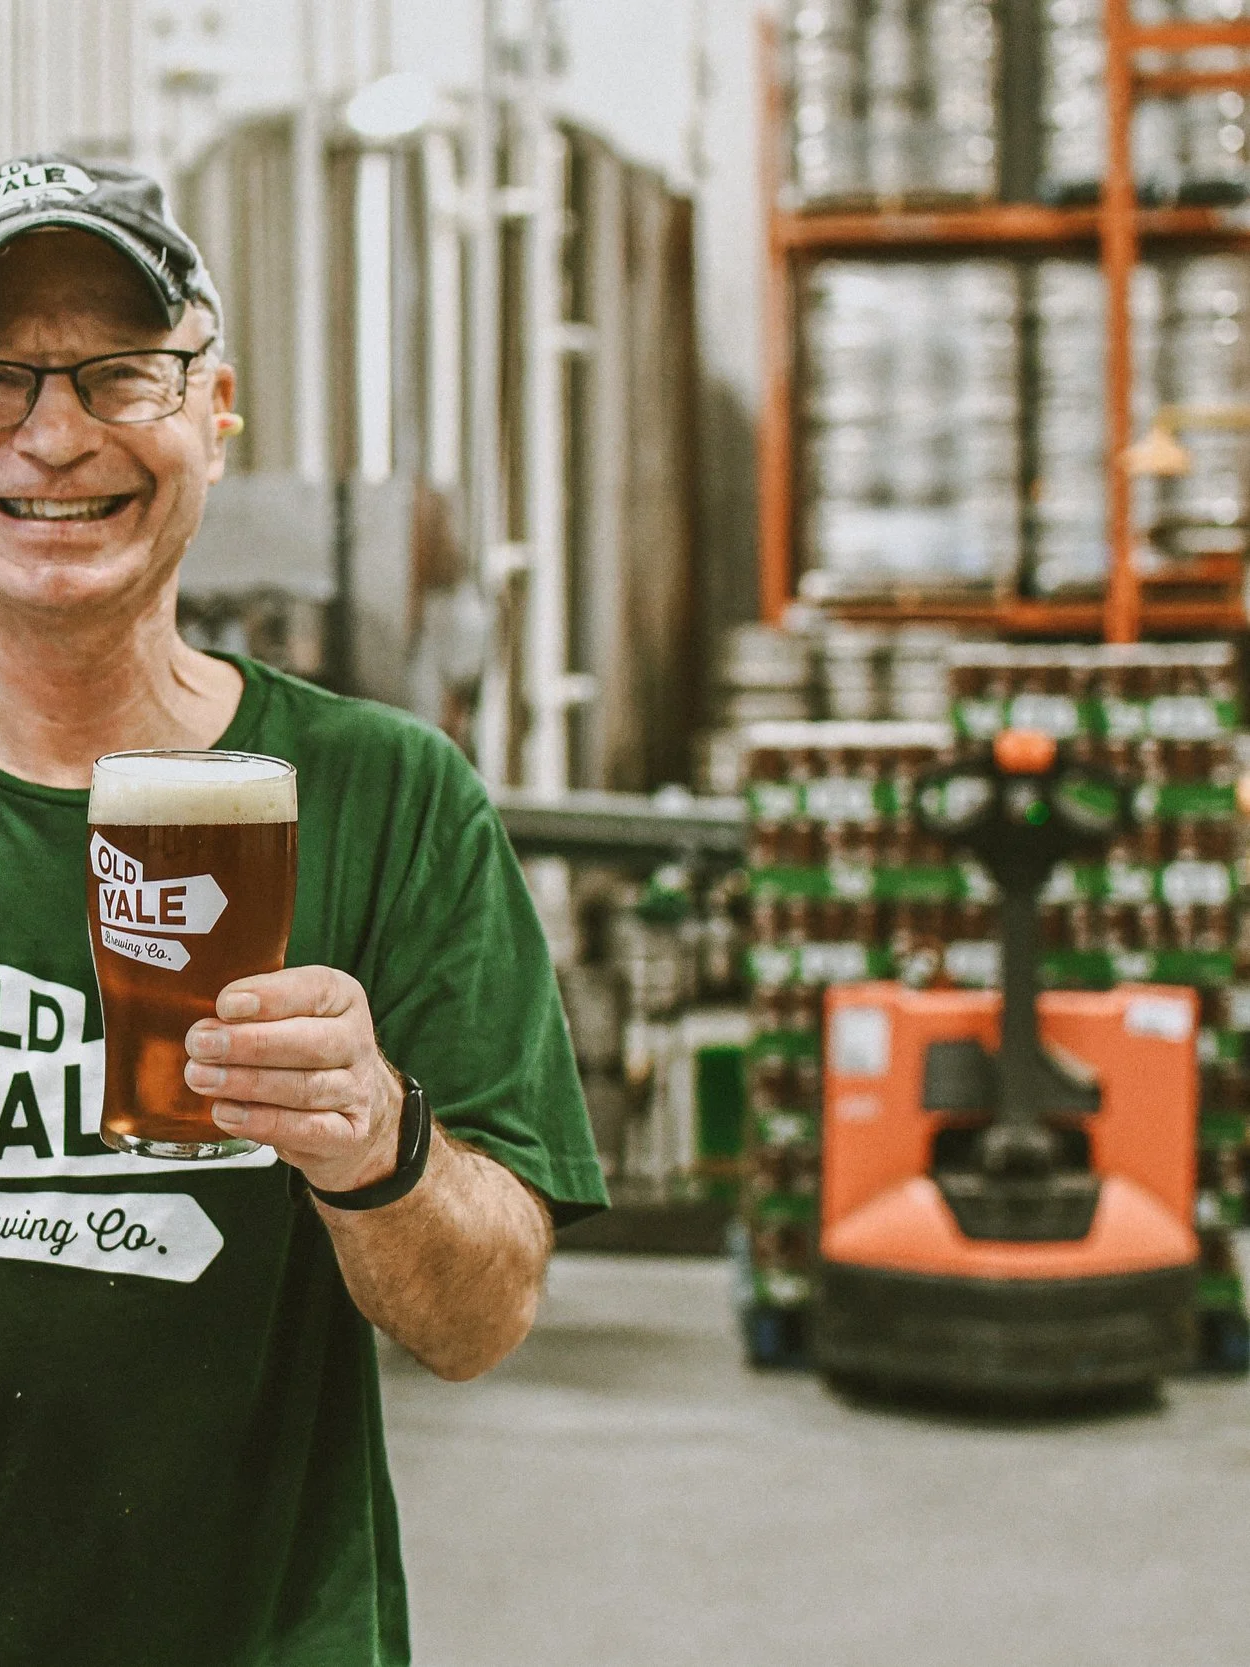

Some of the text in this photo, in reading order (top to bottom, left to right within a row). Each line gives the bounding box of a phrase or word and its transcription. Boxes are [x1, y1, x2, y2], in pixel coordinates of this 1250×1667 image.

[97, 845, 137, 885] OLD
[102, 885, 187, 926] YALE
[104, 930, 173, 962] Brewing Co.
[86, 1207, 168, 1255] Co.
